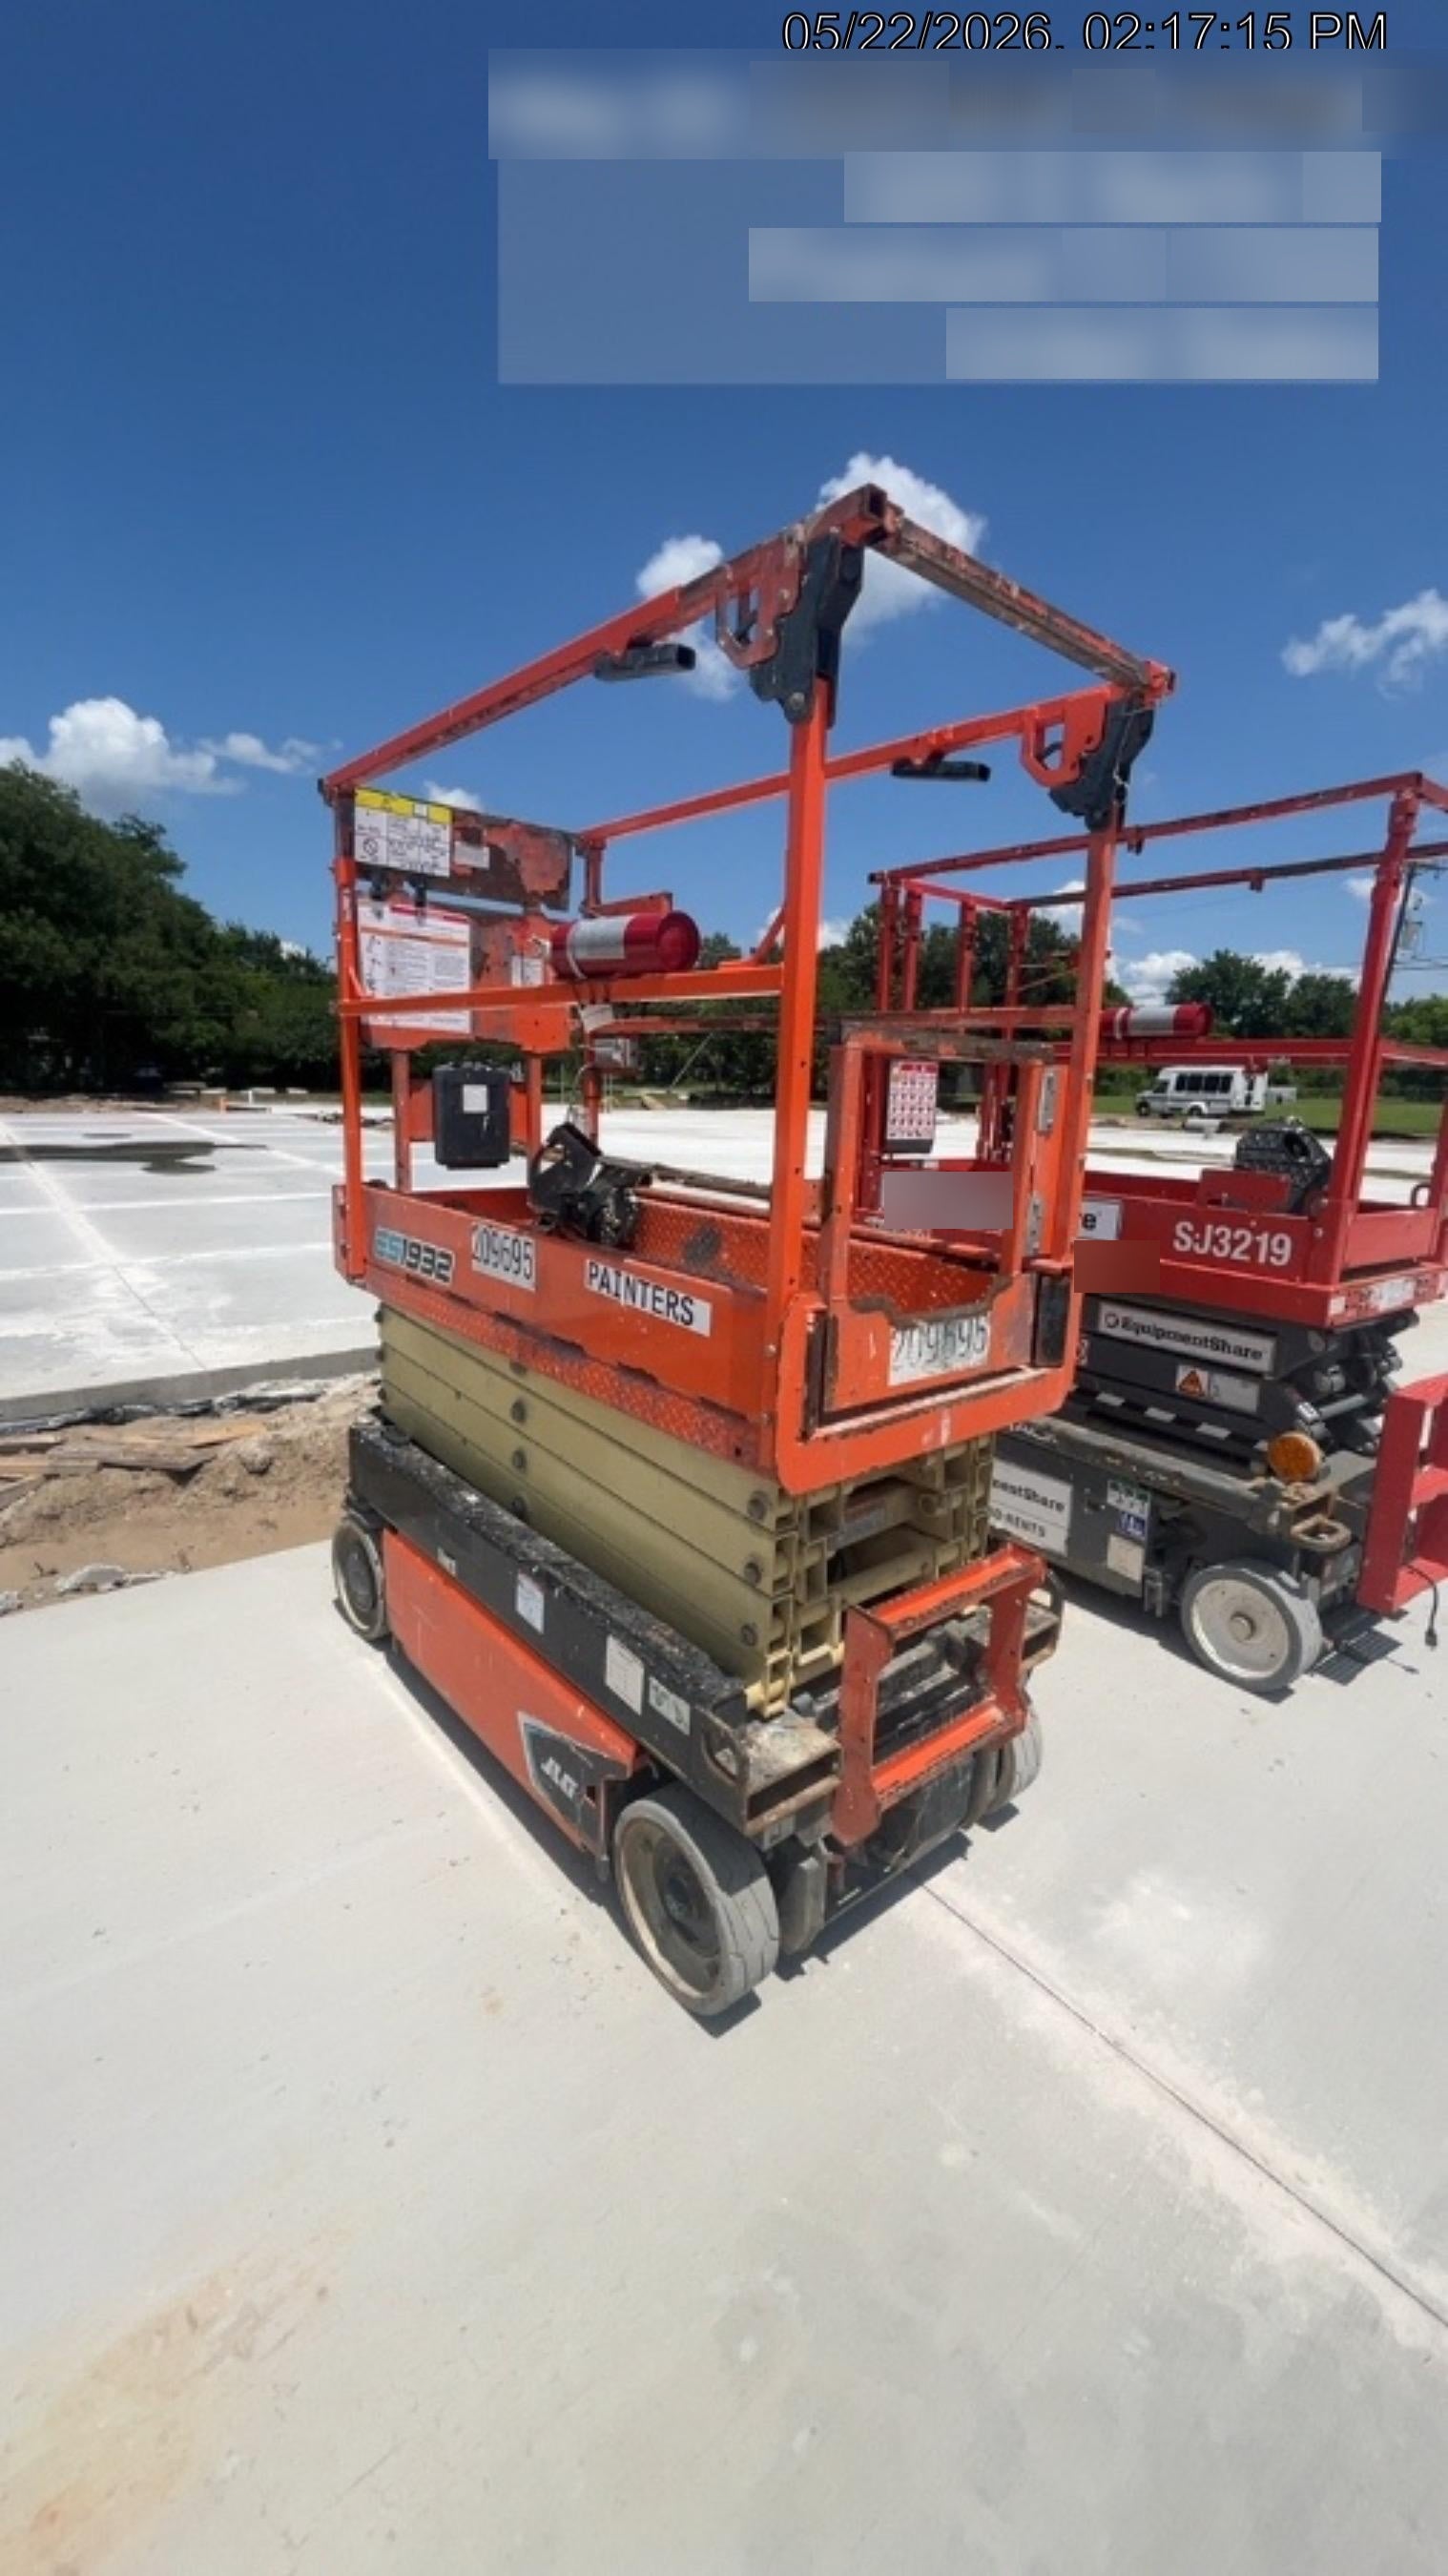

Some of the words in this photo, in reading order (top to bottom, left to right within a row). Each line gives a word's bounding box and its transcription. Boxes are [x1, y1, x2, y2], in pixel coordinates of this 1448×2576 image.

[375, 1229, 453, 1283] ES1932
[1173, 1220, 1292, 1267] SJ3219
[589, 1261, 693, 1326] PAINTERS
[1121, 1315, 1264, 1361] EquipmentShare
